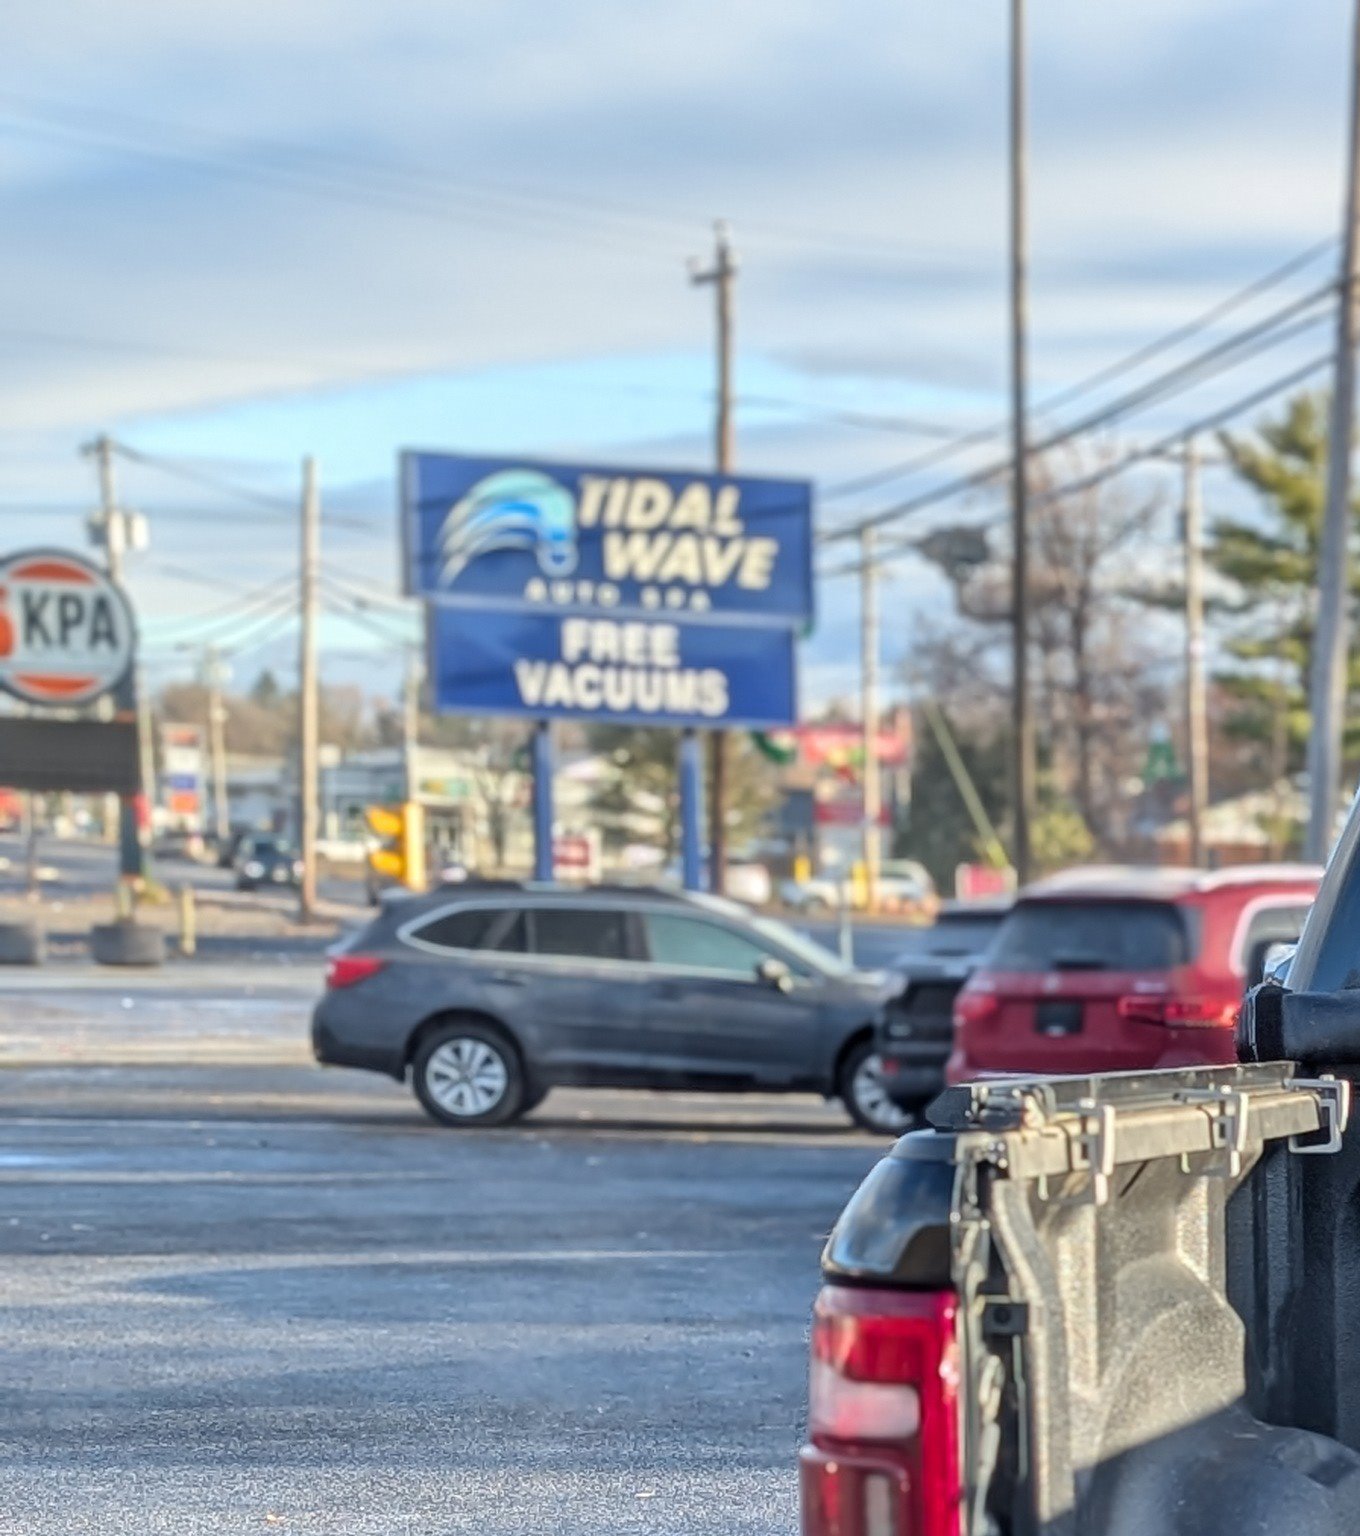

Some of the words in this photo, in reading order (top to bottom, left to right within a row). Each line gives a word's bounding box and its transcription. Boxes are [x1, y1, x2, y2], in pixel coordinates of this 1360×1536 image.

[577, 474, 744, 537] TIDAL
[603, 530, 779, 590] WAVE
[21, 589, 119, 649] KPA
[561, 617, 681, 668] FREE
[514, 657, 730, 718] VACUUMS
